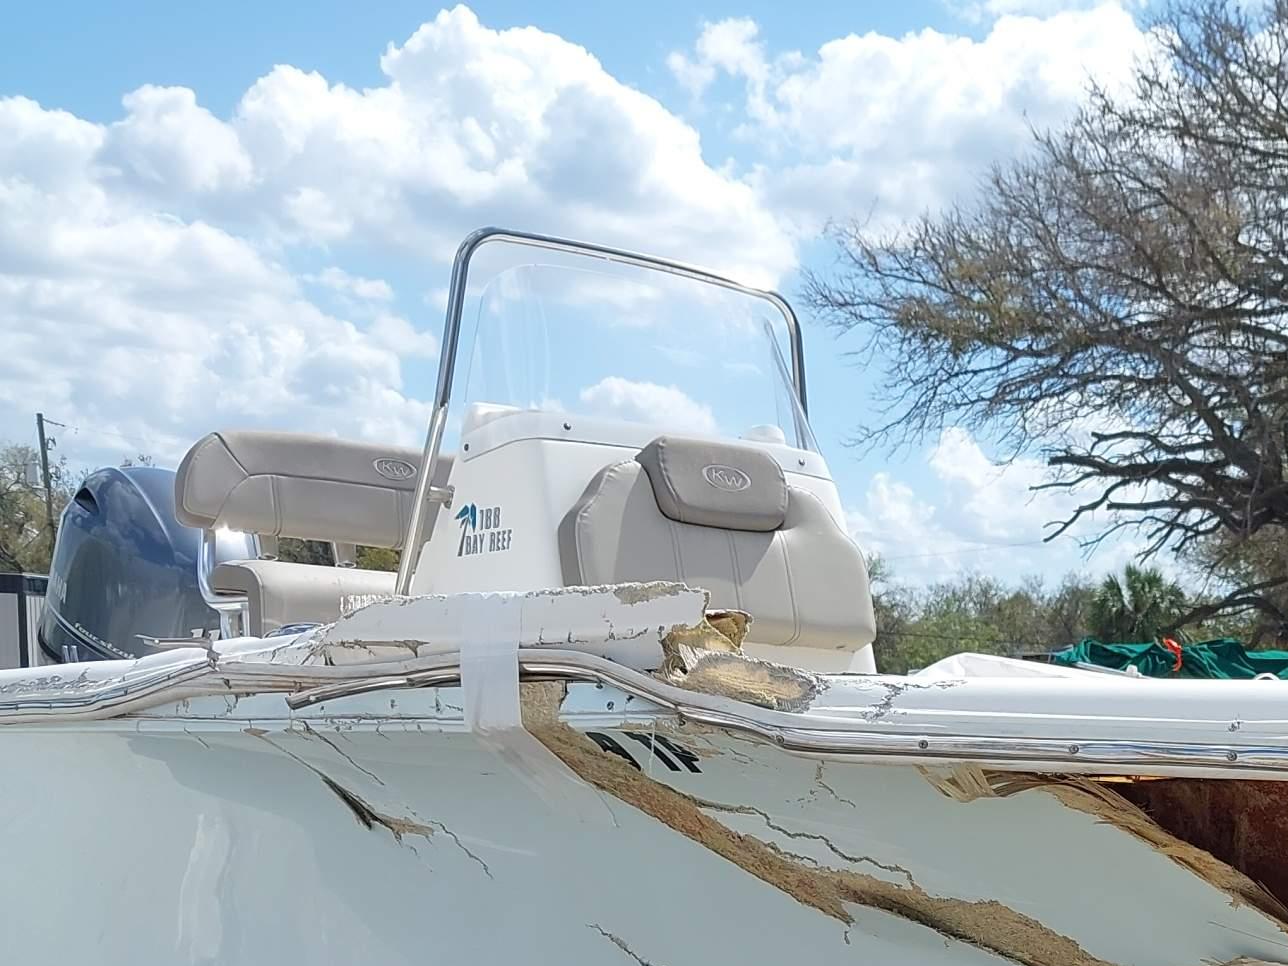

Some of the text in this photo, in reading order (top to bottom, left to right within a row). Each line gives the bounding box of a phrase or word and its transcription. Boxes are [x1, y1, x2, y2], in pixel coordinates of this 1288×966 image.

[712, 469, 742, 486] KW
[465, 529, 512, 555] BAY REEF
